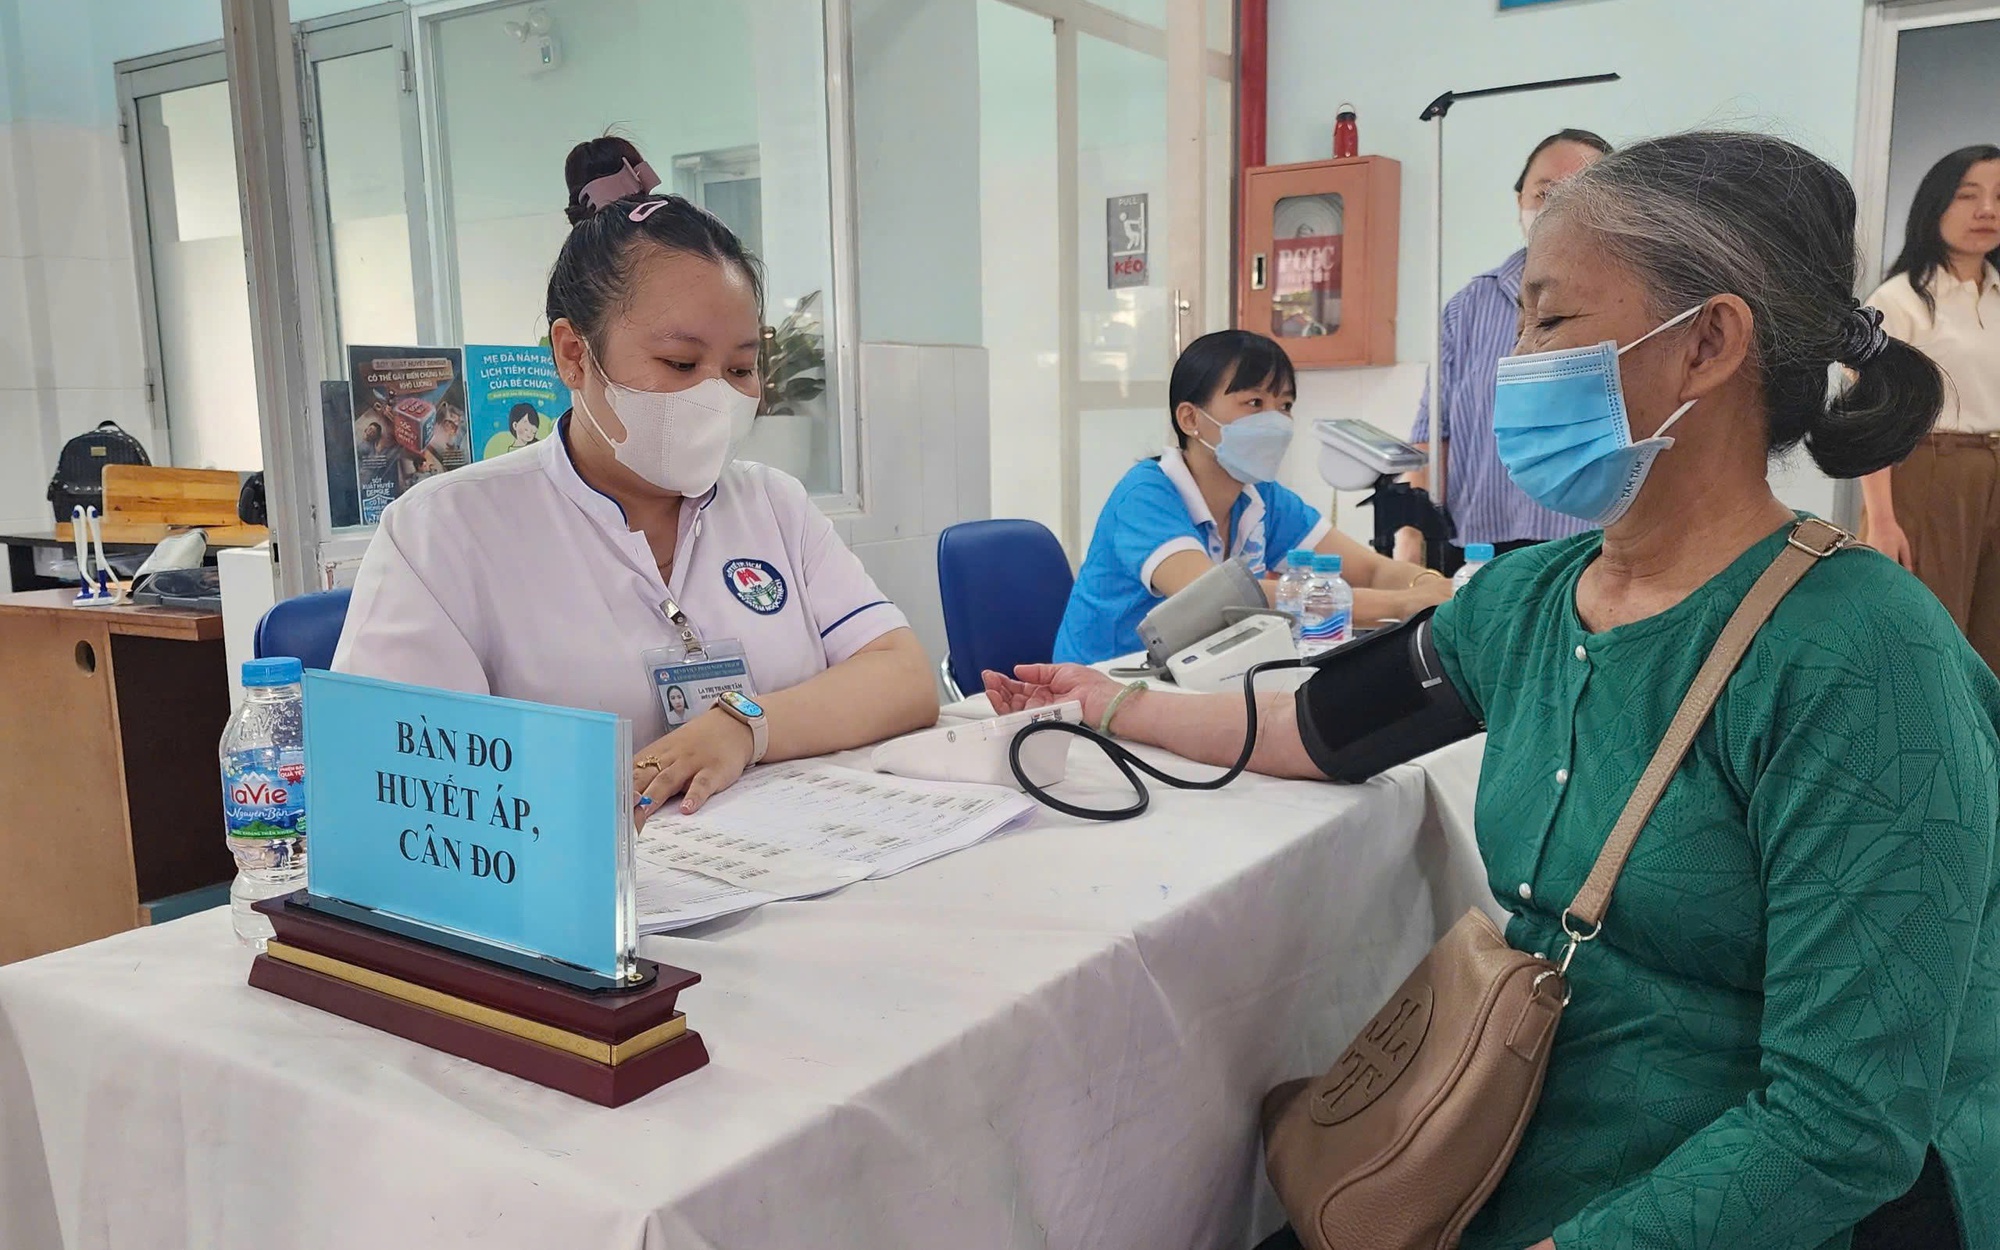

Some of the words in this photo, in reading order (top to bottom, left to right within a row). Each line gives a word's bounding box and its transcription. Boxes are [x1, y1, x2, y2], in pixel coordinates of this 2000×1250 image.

[1115, 256, 1143, 275] KÉO
[483, 354, 499, 366] MẸ
[500, 351, 515, 362] ĐÃ
[481, 367, 502, 379] LỊCH
[503, 364, 526, 375] TIÊM
[489, 378, 509, 389] CỦA
[510, 377, 522, 388] BÉ
[396, 715, 457, 763] BÀN
[466, 733, 512, 772] ĐO
[230, 783, 287, 805] laVie
[375, 770, 479, 821] HUYẾT
[489, 784, 540, 842] ÁP,
[400, 823, 461, 872] CÂN
[470, 843, 515, 884] ĐO
